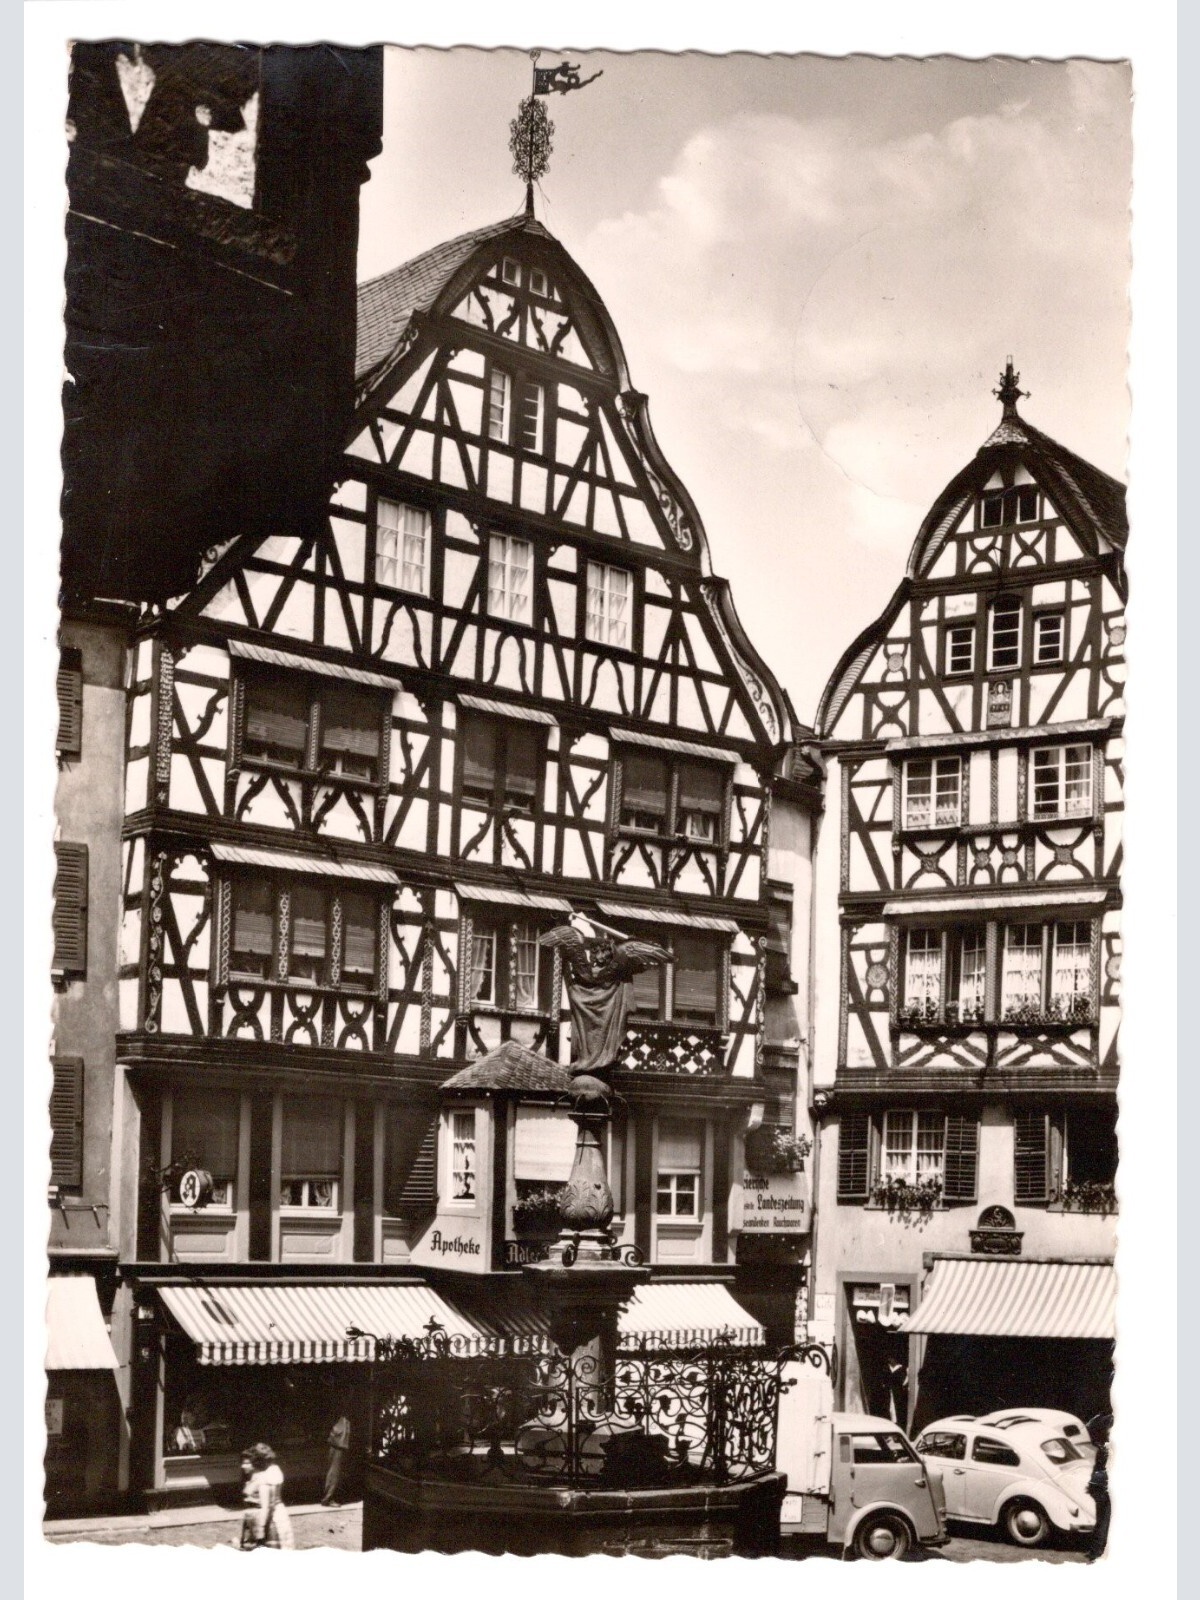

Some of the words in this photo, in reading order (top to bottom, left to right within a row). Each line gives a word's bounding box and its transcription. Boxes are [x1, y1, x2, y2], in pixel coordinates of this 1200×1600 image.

[182, 1173, 197, 1200] A
[757, 1194, 804, 1213] Landeszeitung
[431, 1230, 480, 1256] Apotheke
